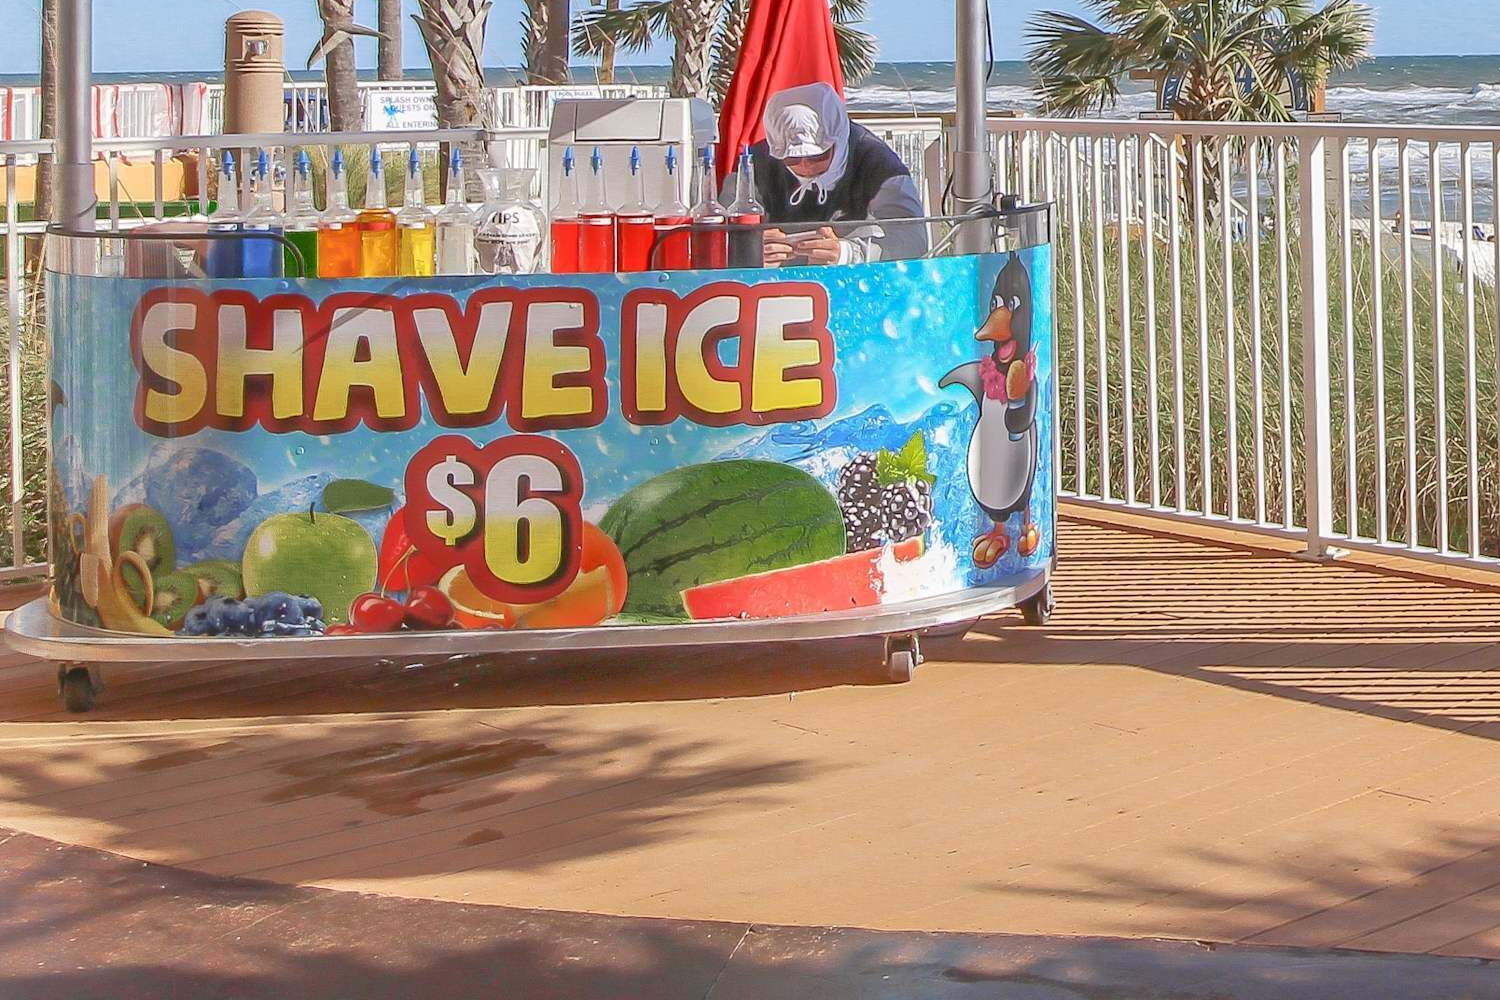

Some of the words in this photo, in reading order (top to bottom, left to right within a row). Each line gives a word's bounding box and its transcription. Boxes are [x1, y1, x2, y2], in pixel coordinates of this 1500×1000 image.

[380, 96, 411, 104] SPLASH
[385, 121, 400, 129] ALL
[141, 301, 594, 423] SHAVE
[637, 295, 824, 414] ICE
[425, 454, 564, 585] $6
